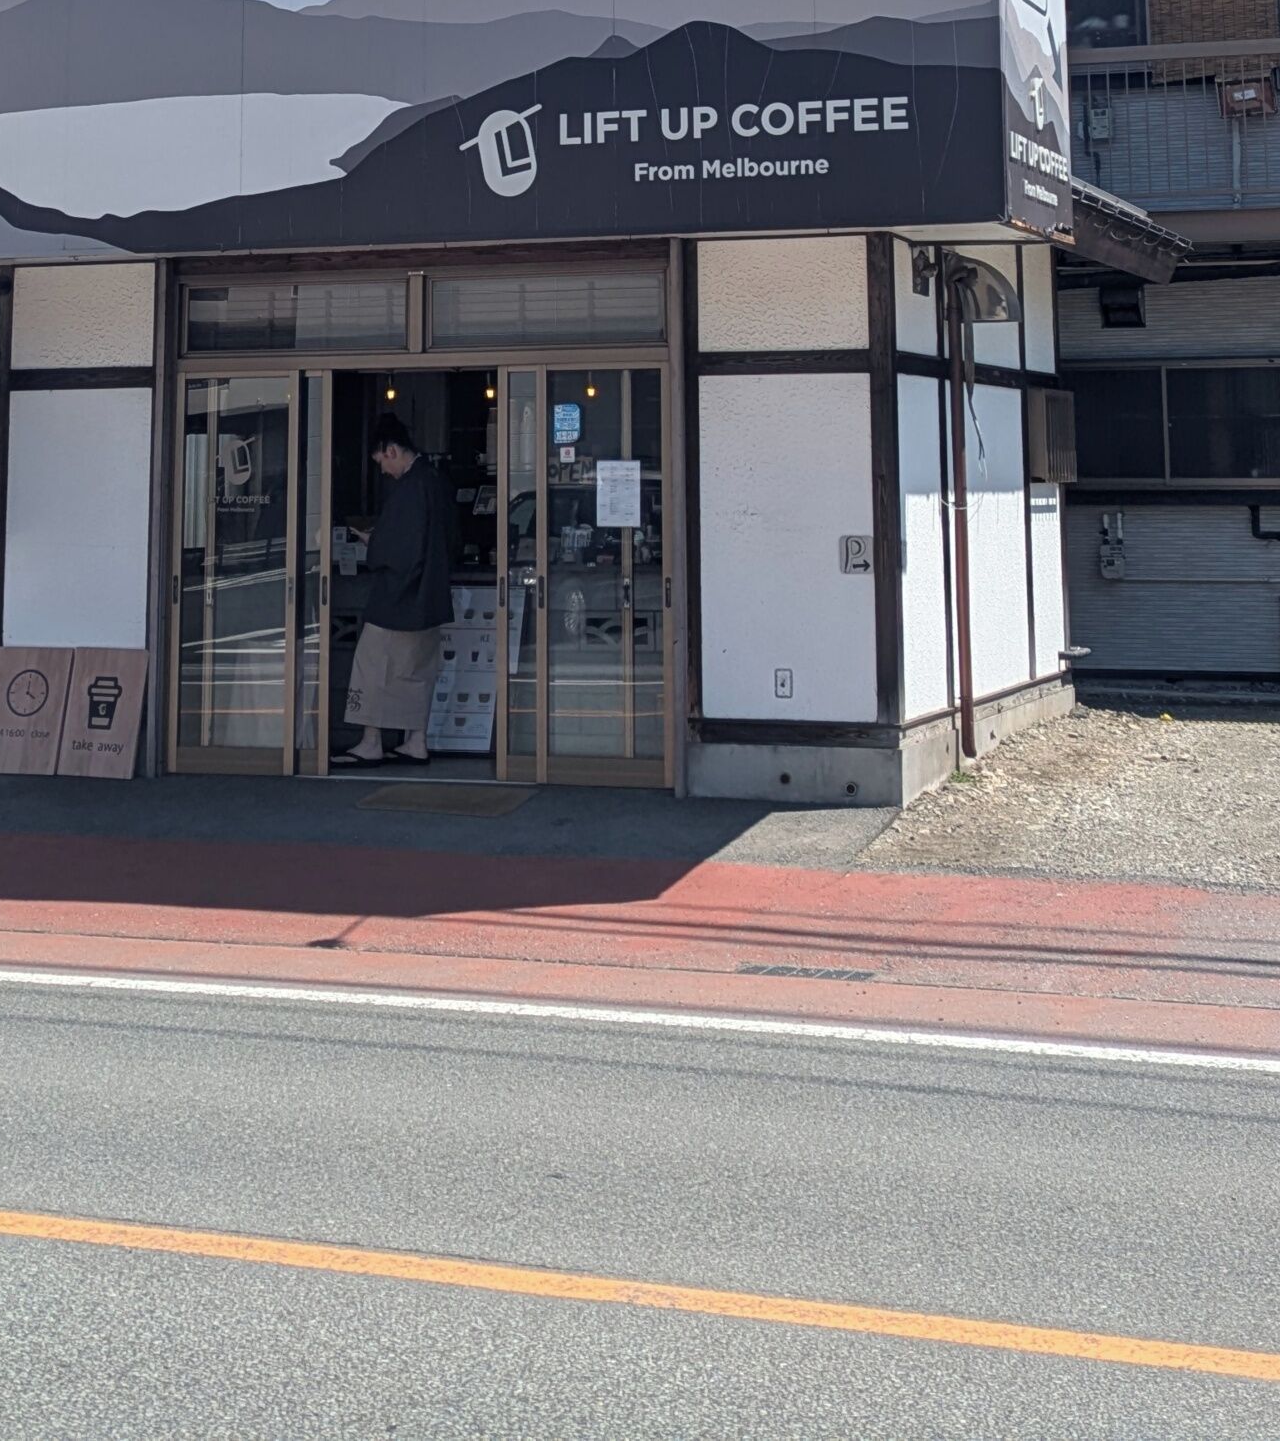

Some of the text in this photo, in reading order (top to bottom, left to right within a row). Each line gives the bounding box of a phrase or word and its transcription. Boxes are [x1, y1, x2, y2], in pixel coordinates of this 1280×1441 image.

[558, 95, 910, 146] LIFT UP COFFEE
[633, 156, 830, 182] From Melbourne
[1009, 130, 1069, 182] LIFT UP COFFEE
[844, 535, 867, 574] P
[30, 729, 50, 739] close
[71, 739, 124, 755] take away
